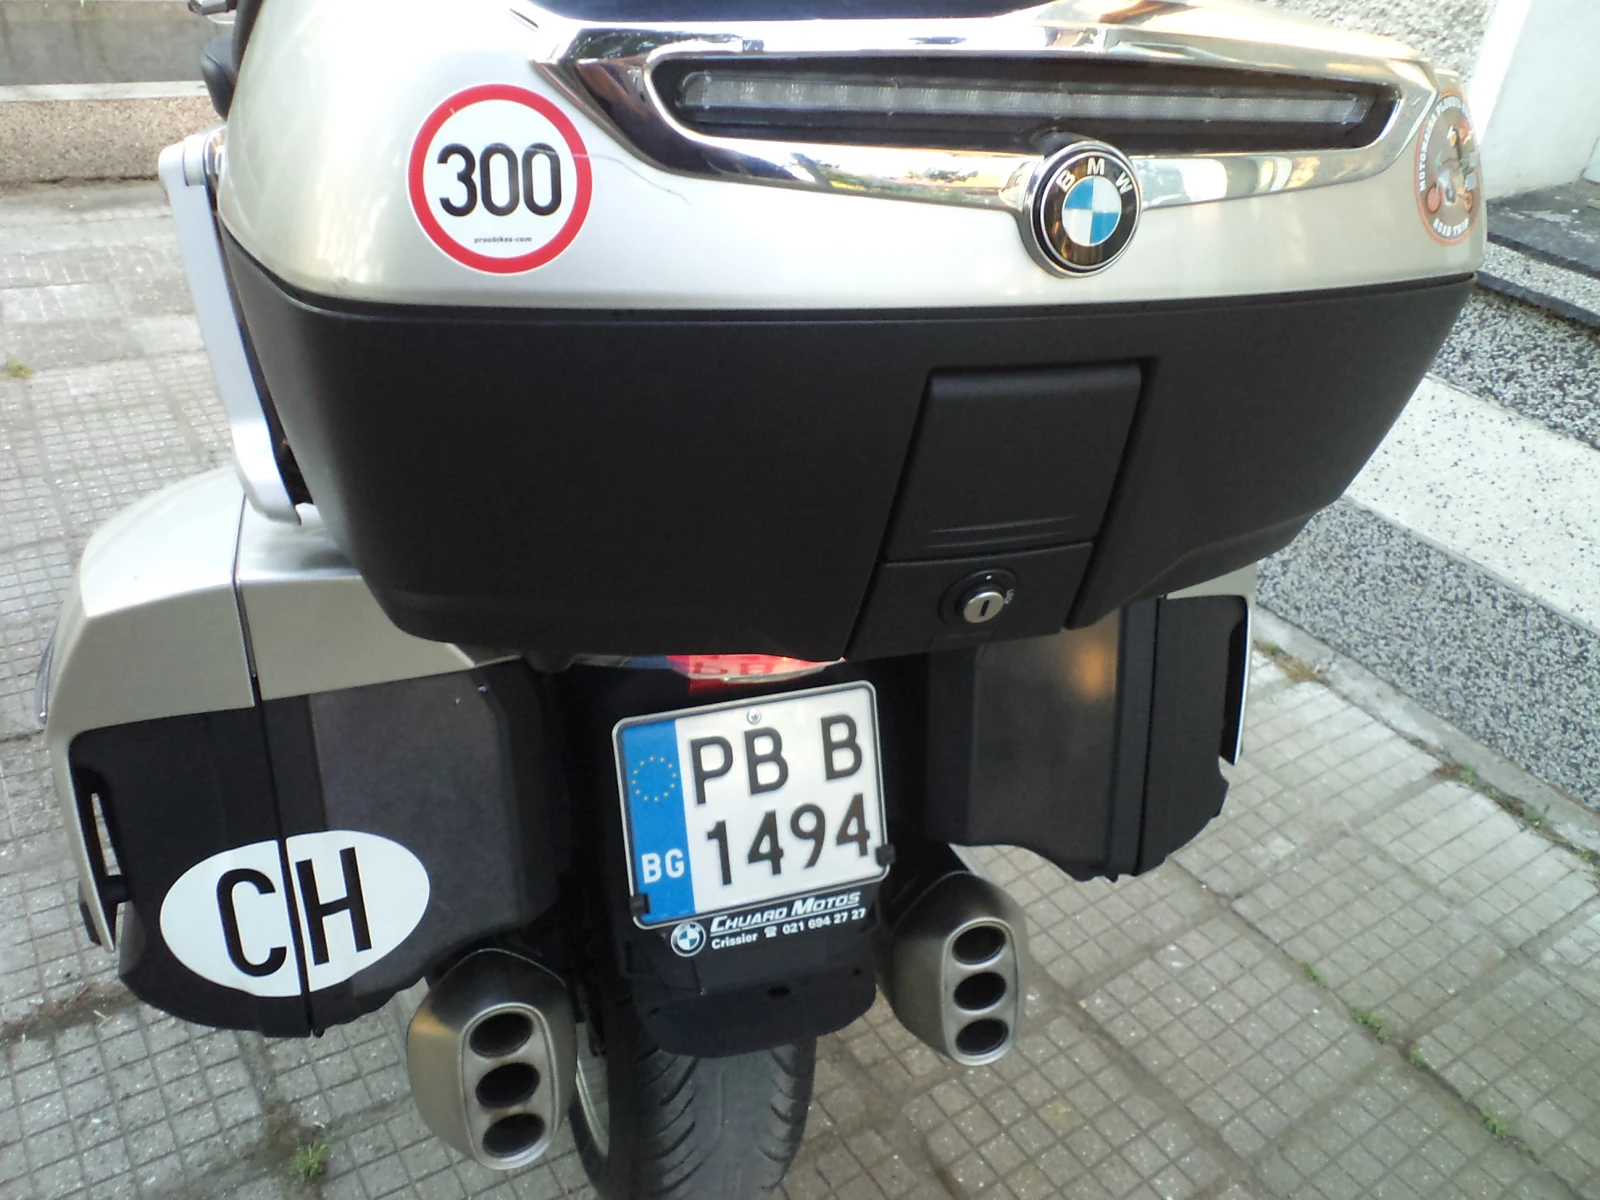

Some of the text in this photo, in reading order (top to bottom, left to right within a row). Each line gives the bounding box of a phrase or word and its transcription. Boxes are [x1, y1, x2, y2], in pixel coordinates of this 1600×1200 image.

[437, 142, 562, 217] 300
[1055, 157, 1133, 194] BMW
[1433, 217, 1452, 237] ROAD
[690, 714, 863, 805] PB B
[641, 849, 685, 883] BG
[706, 793, 871, 886] 1494
[216, 846, 373, 977] CH
[711, 907, 866, 950] Crissier 021 694 27 27
